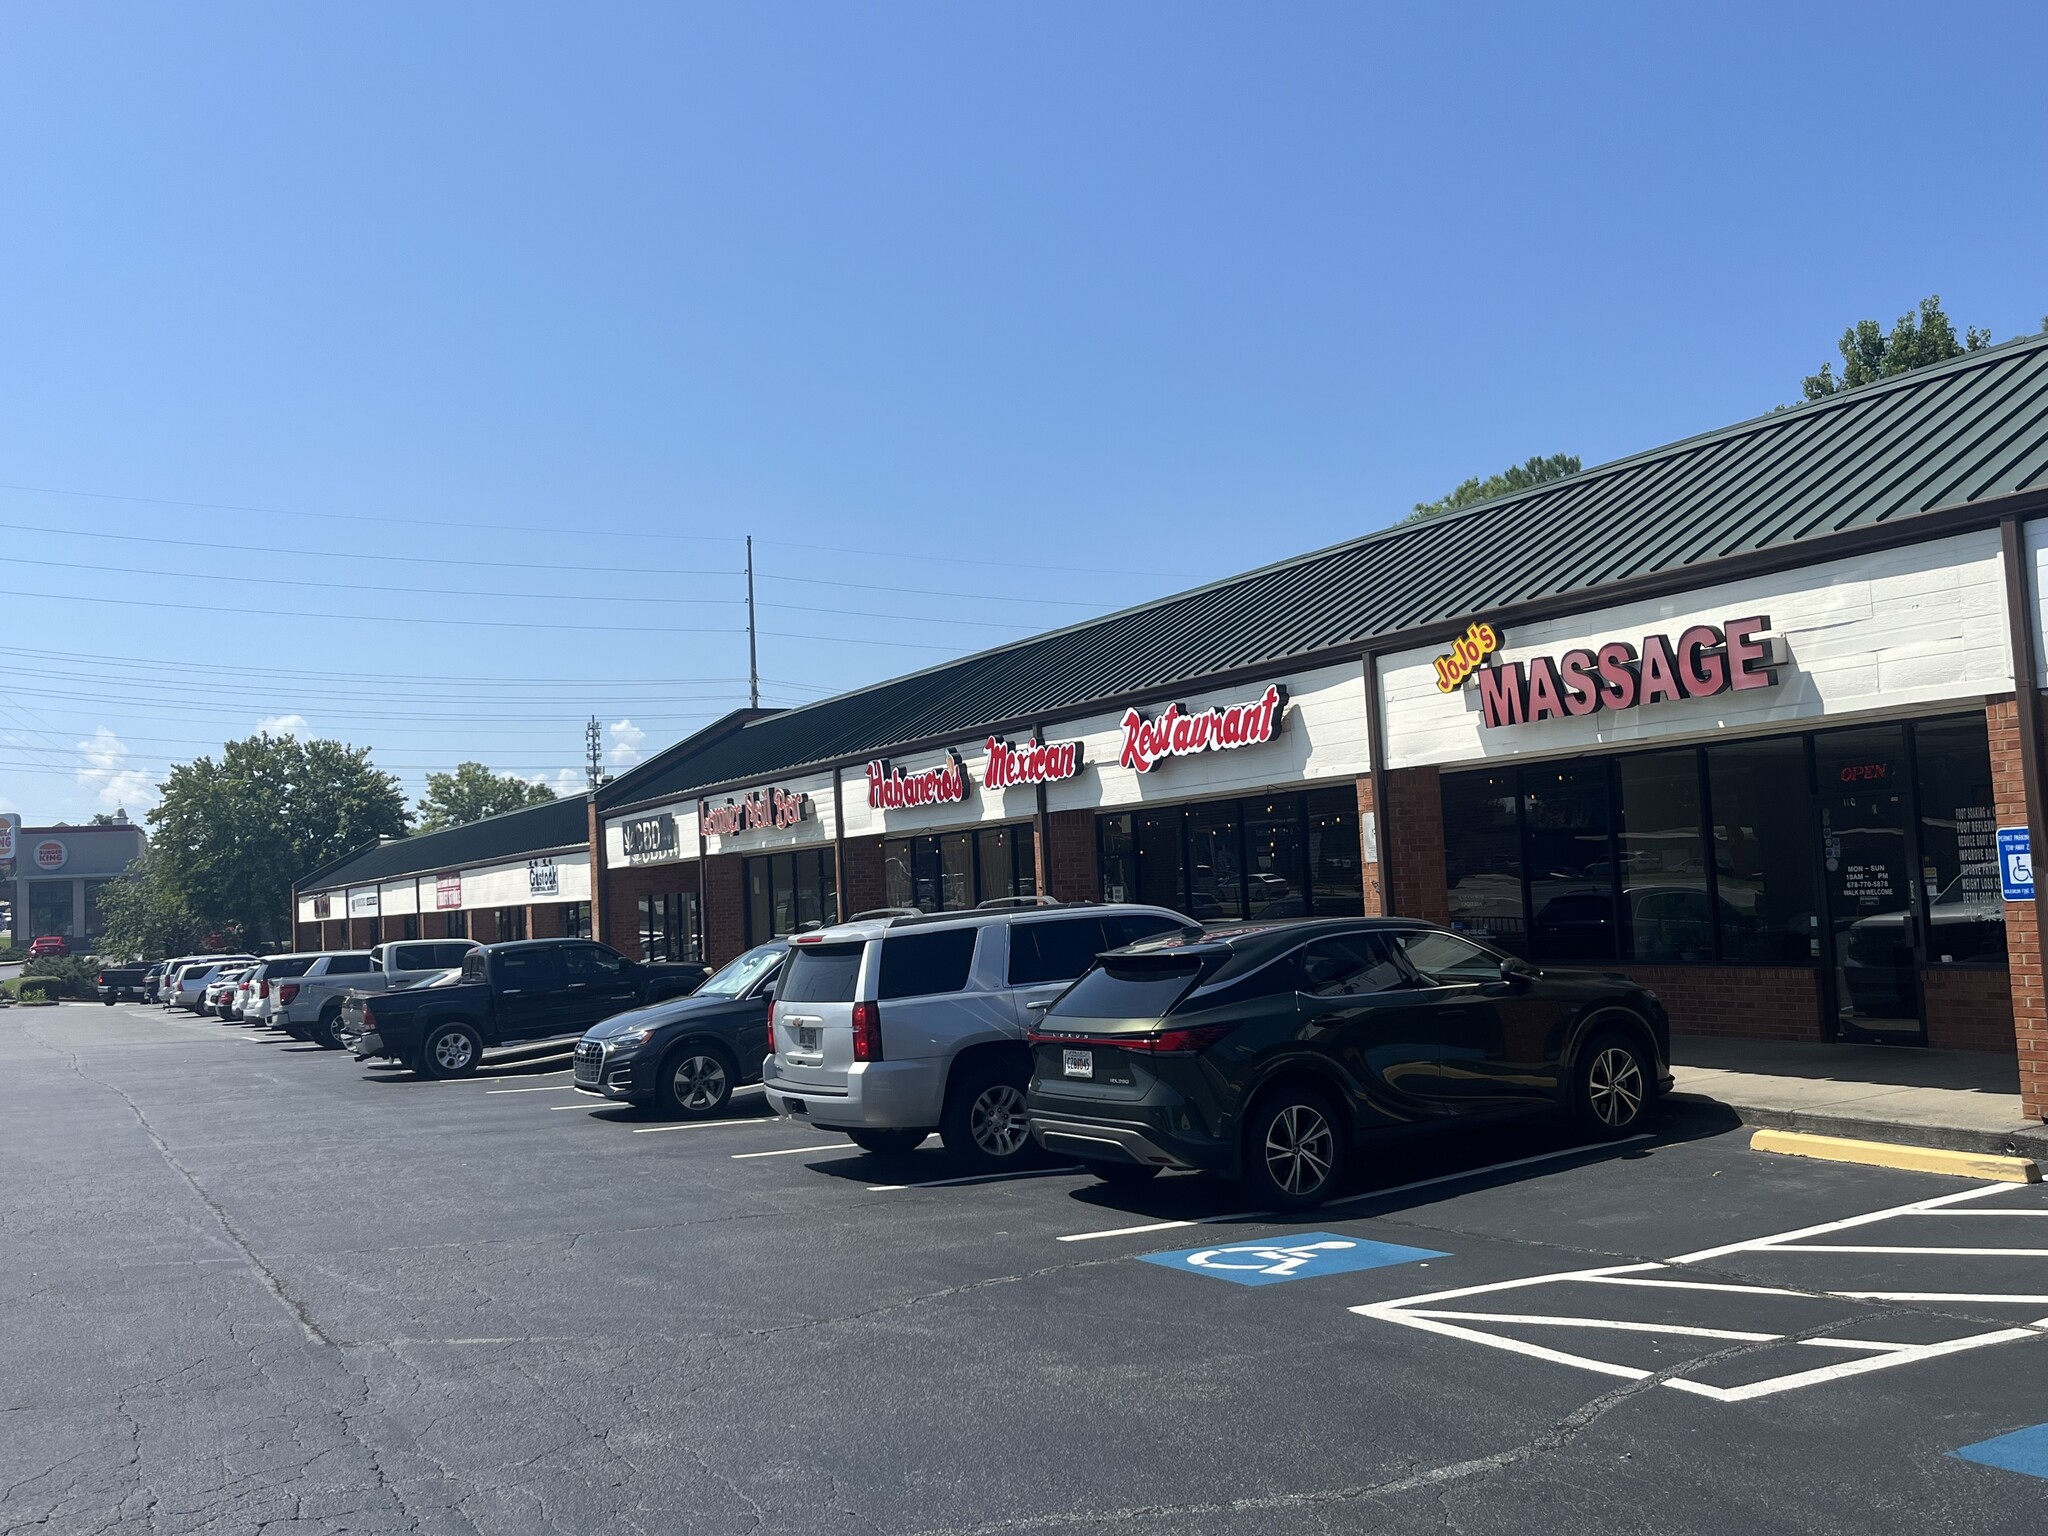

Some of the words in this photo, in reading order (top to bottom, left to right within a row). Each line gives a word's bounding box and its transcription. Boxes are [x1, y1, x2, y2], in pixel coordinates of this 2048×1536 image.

[1435, 622, 1496, 693] JoJo's
[1477, 616, 1770, 729] MASSAGE
[865, 749, 965, 809] Habanero's
[983, 736, 1077, 789] Mexican
[1119, 685, 1281, 773] Restaurant
[1840, 764, 1887, 782] OPEN
[745, 788, 772, 830] Nail
[774, 787, 802, 831] Bar
[1956, 821, 1970, 834] FOOT
[1870, 864, 1885, 872] SUN
[1877, 872, 1889, 880] PM
[1981, 877, 1994, 890] LOSS
[1865, 888, 1894, 896] WELCOME
